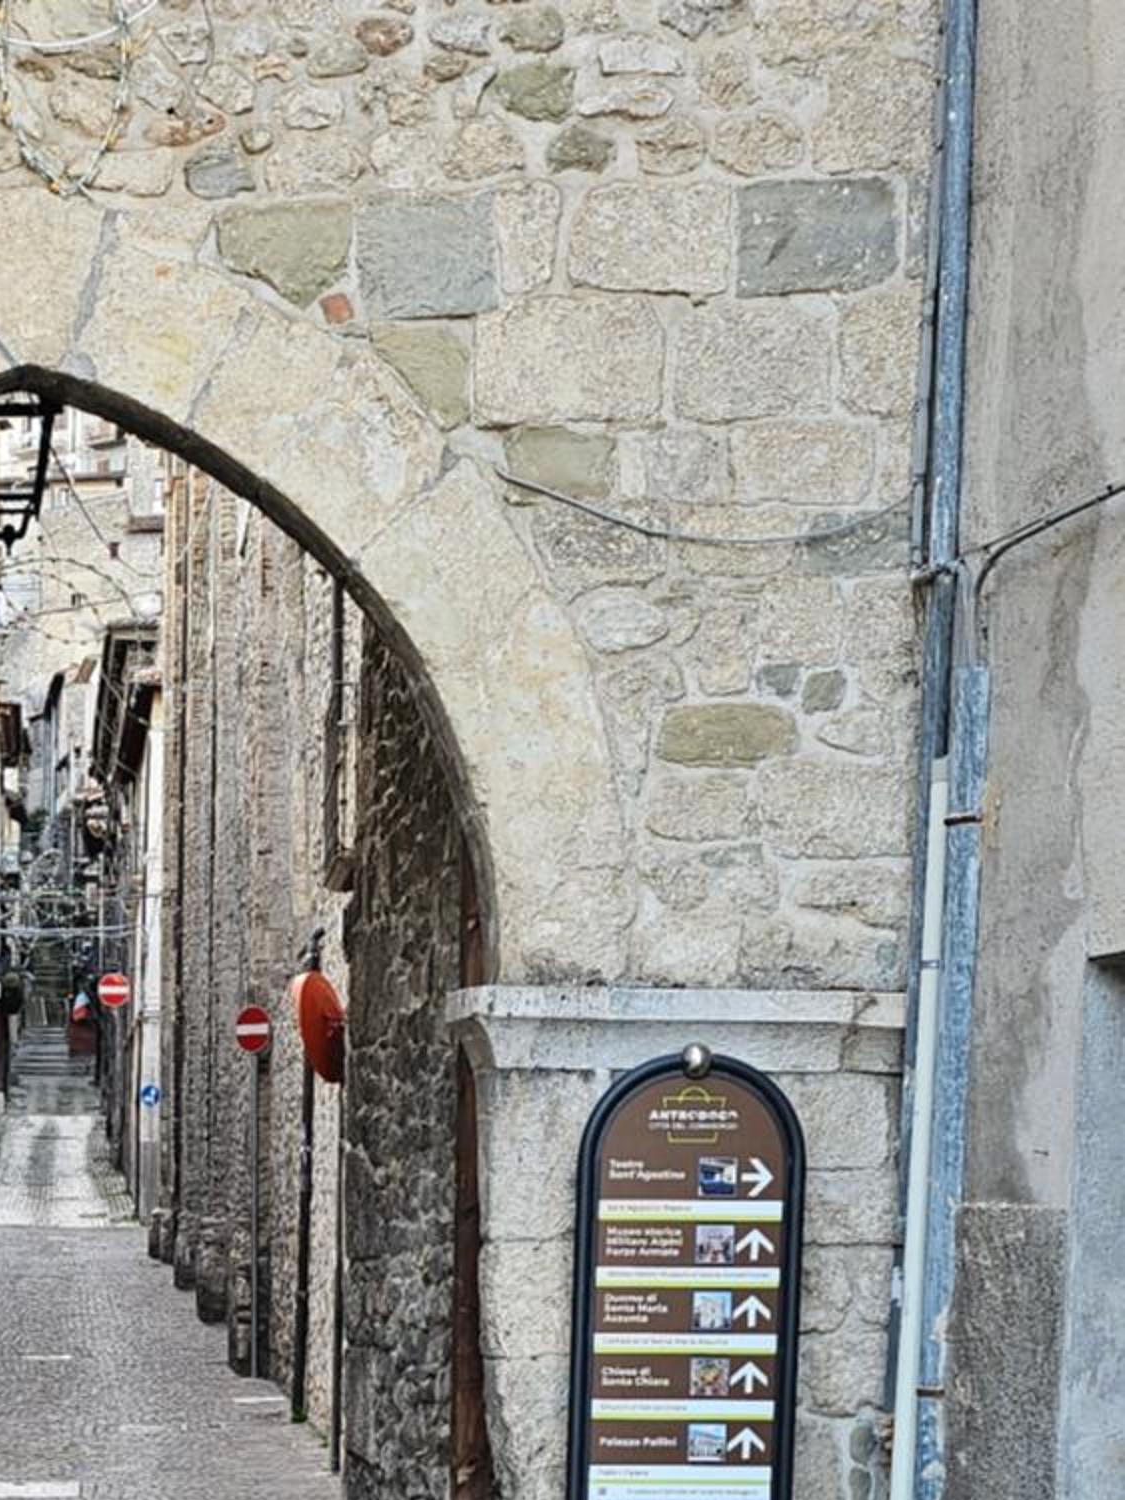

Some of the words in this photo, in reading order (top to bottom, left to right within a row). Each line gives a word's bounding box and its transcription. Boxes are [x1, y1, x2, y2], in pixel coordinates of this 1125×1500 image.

[649, 1109, 739, 1120] ANTRODOCO
[608, 1158, 644, 1169] Teatro
[604, 1293, 643, 1303] Duomo
[646, 1293, 657, 1303] di
[603, 1303, 635, 1313] Santa
[638, 1303, 668, 1313] Maria
[601, 1366, 637, 1376] Chiesa
[639, 1366, 651, 1376] di
[601, 1377, 632, 1387] Santa
[635, 1377, 670, 1387] Chiara
[599, 1437, 640, 1447] Palazzo
